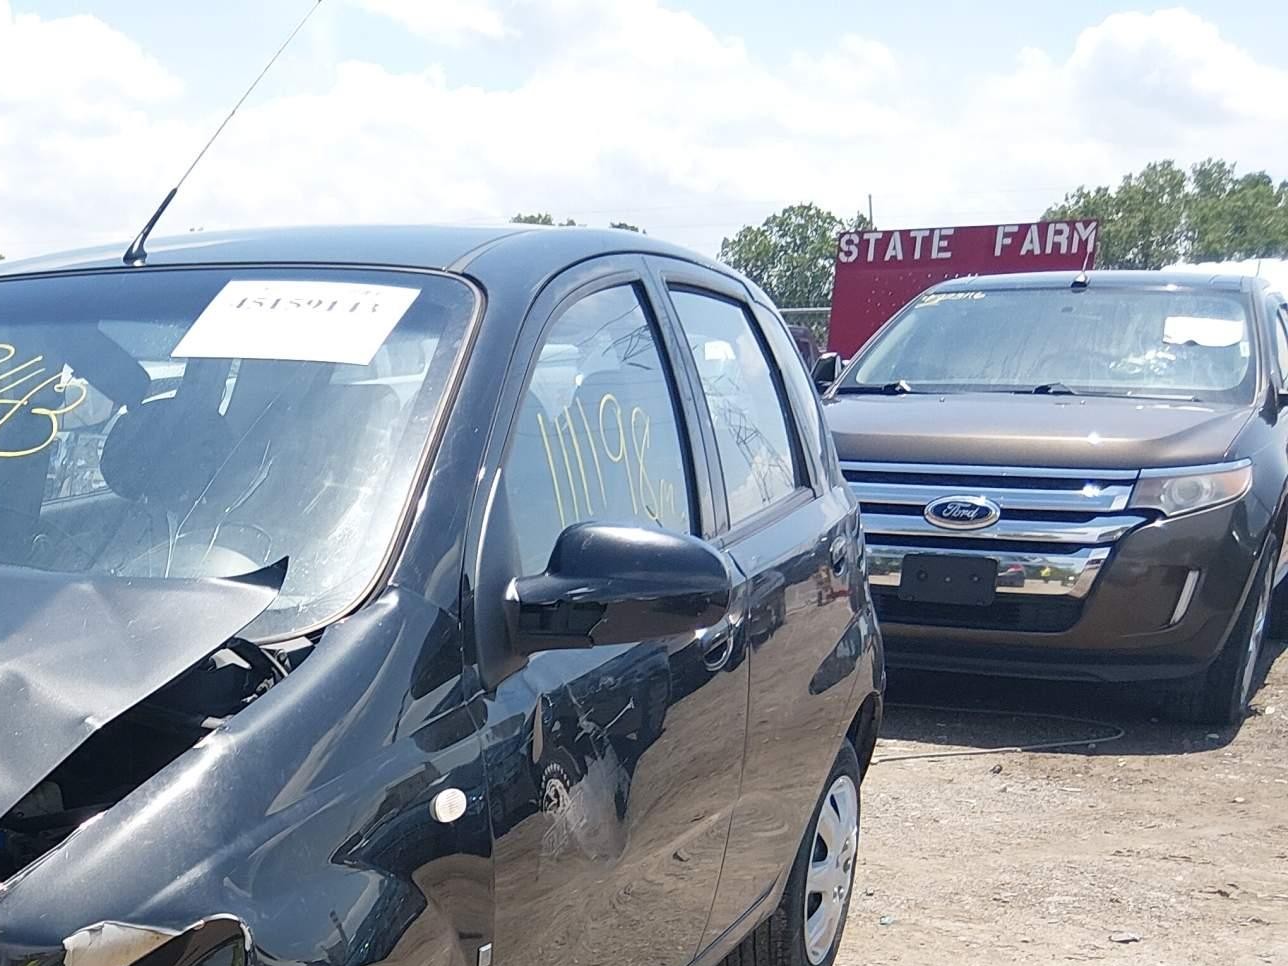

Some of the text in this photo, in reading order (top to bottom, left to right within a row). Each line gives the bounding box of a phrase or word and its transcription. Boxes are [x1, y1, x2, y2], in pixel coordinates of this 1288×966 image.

[838, 220, 1098, 263] STATE FARM
[942, 502, 981, 521] Ford
